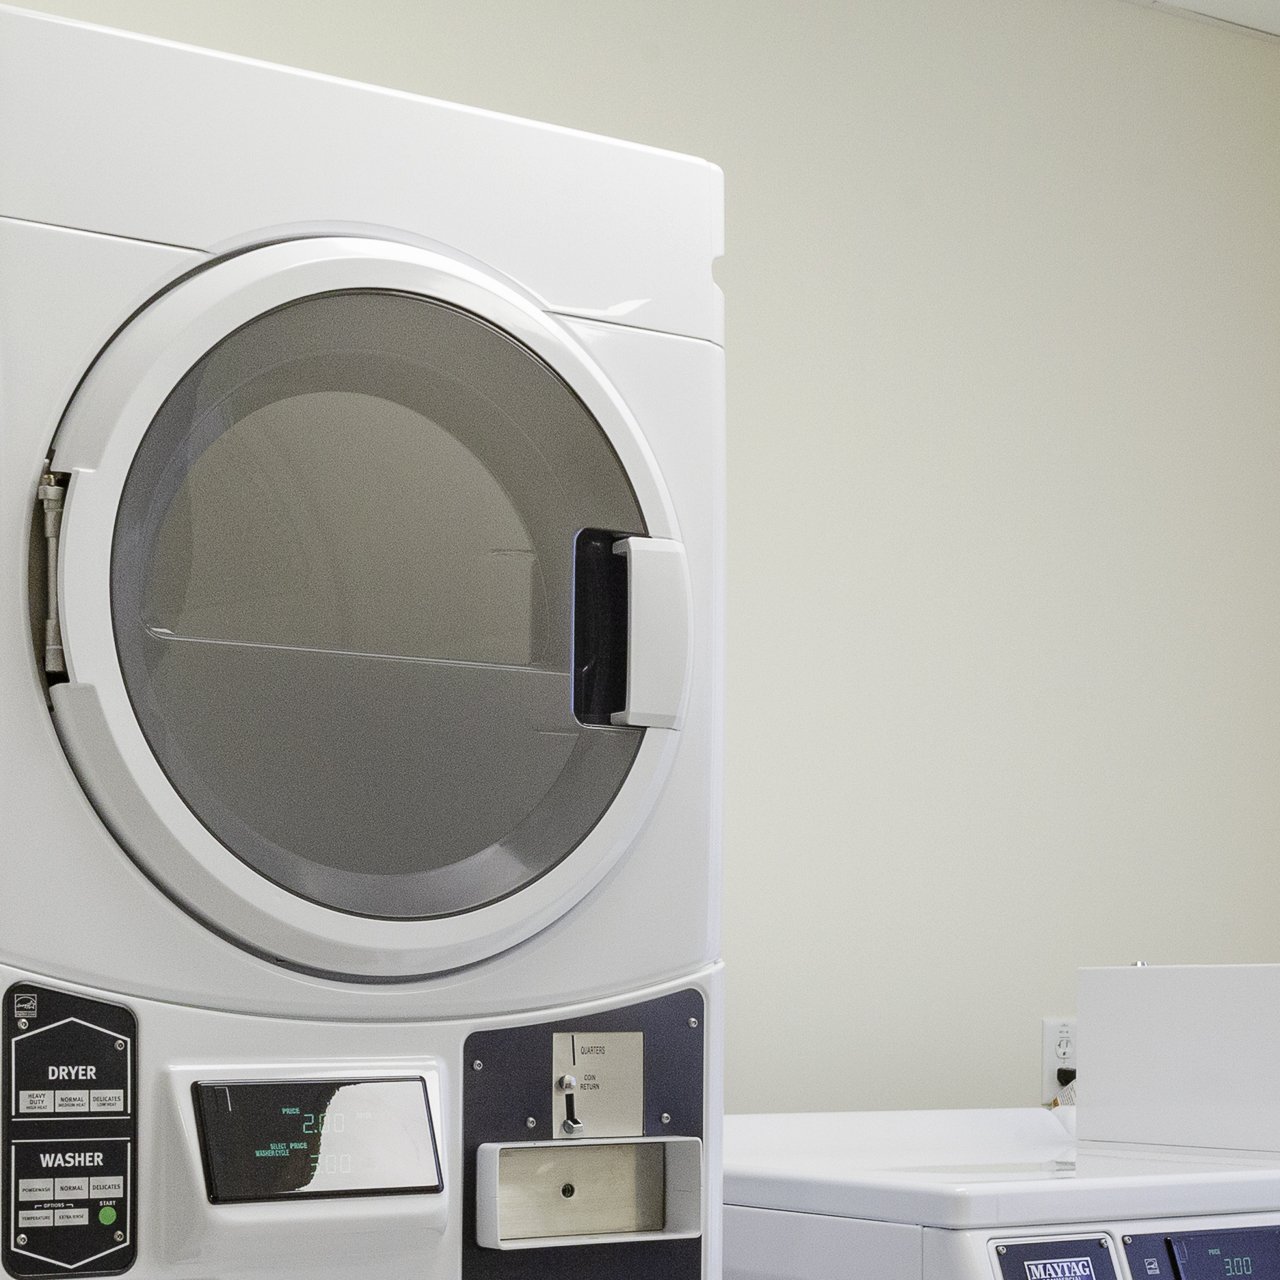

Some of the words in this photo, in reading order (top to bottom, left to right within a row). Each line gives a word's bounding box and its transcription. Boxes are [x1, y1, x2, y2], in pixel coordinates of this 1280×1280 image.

[580, 1046, 605, 1055] QUARTERS
[48, 1065, 97, 1080] DRYER
[580, 1083, 600, 1091] RETURN
[40, 1152, 104, 1168] WASHER
[1028, 1261, 1090, 1280] MAYTAG
[1223, 1257, 1252, 1276] 3.00
